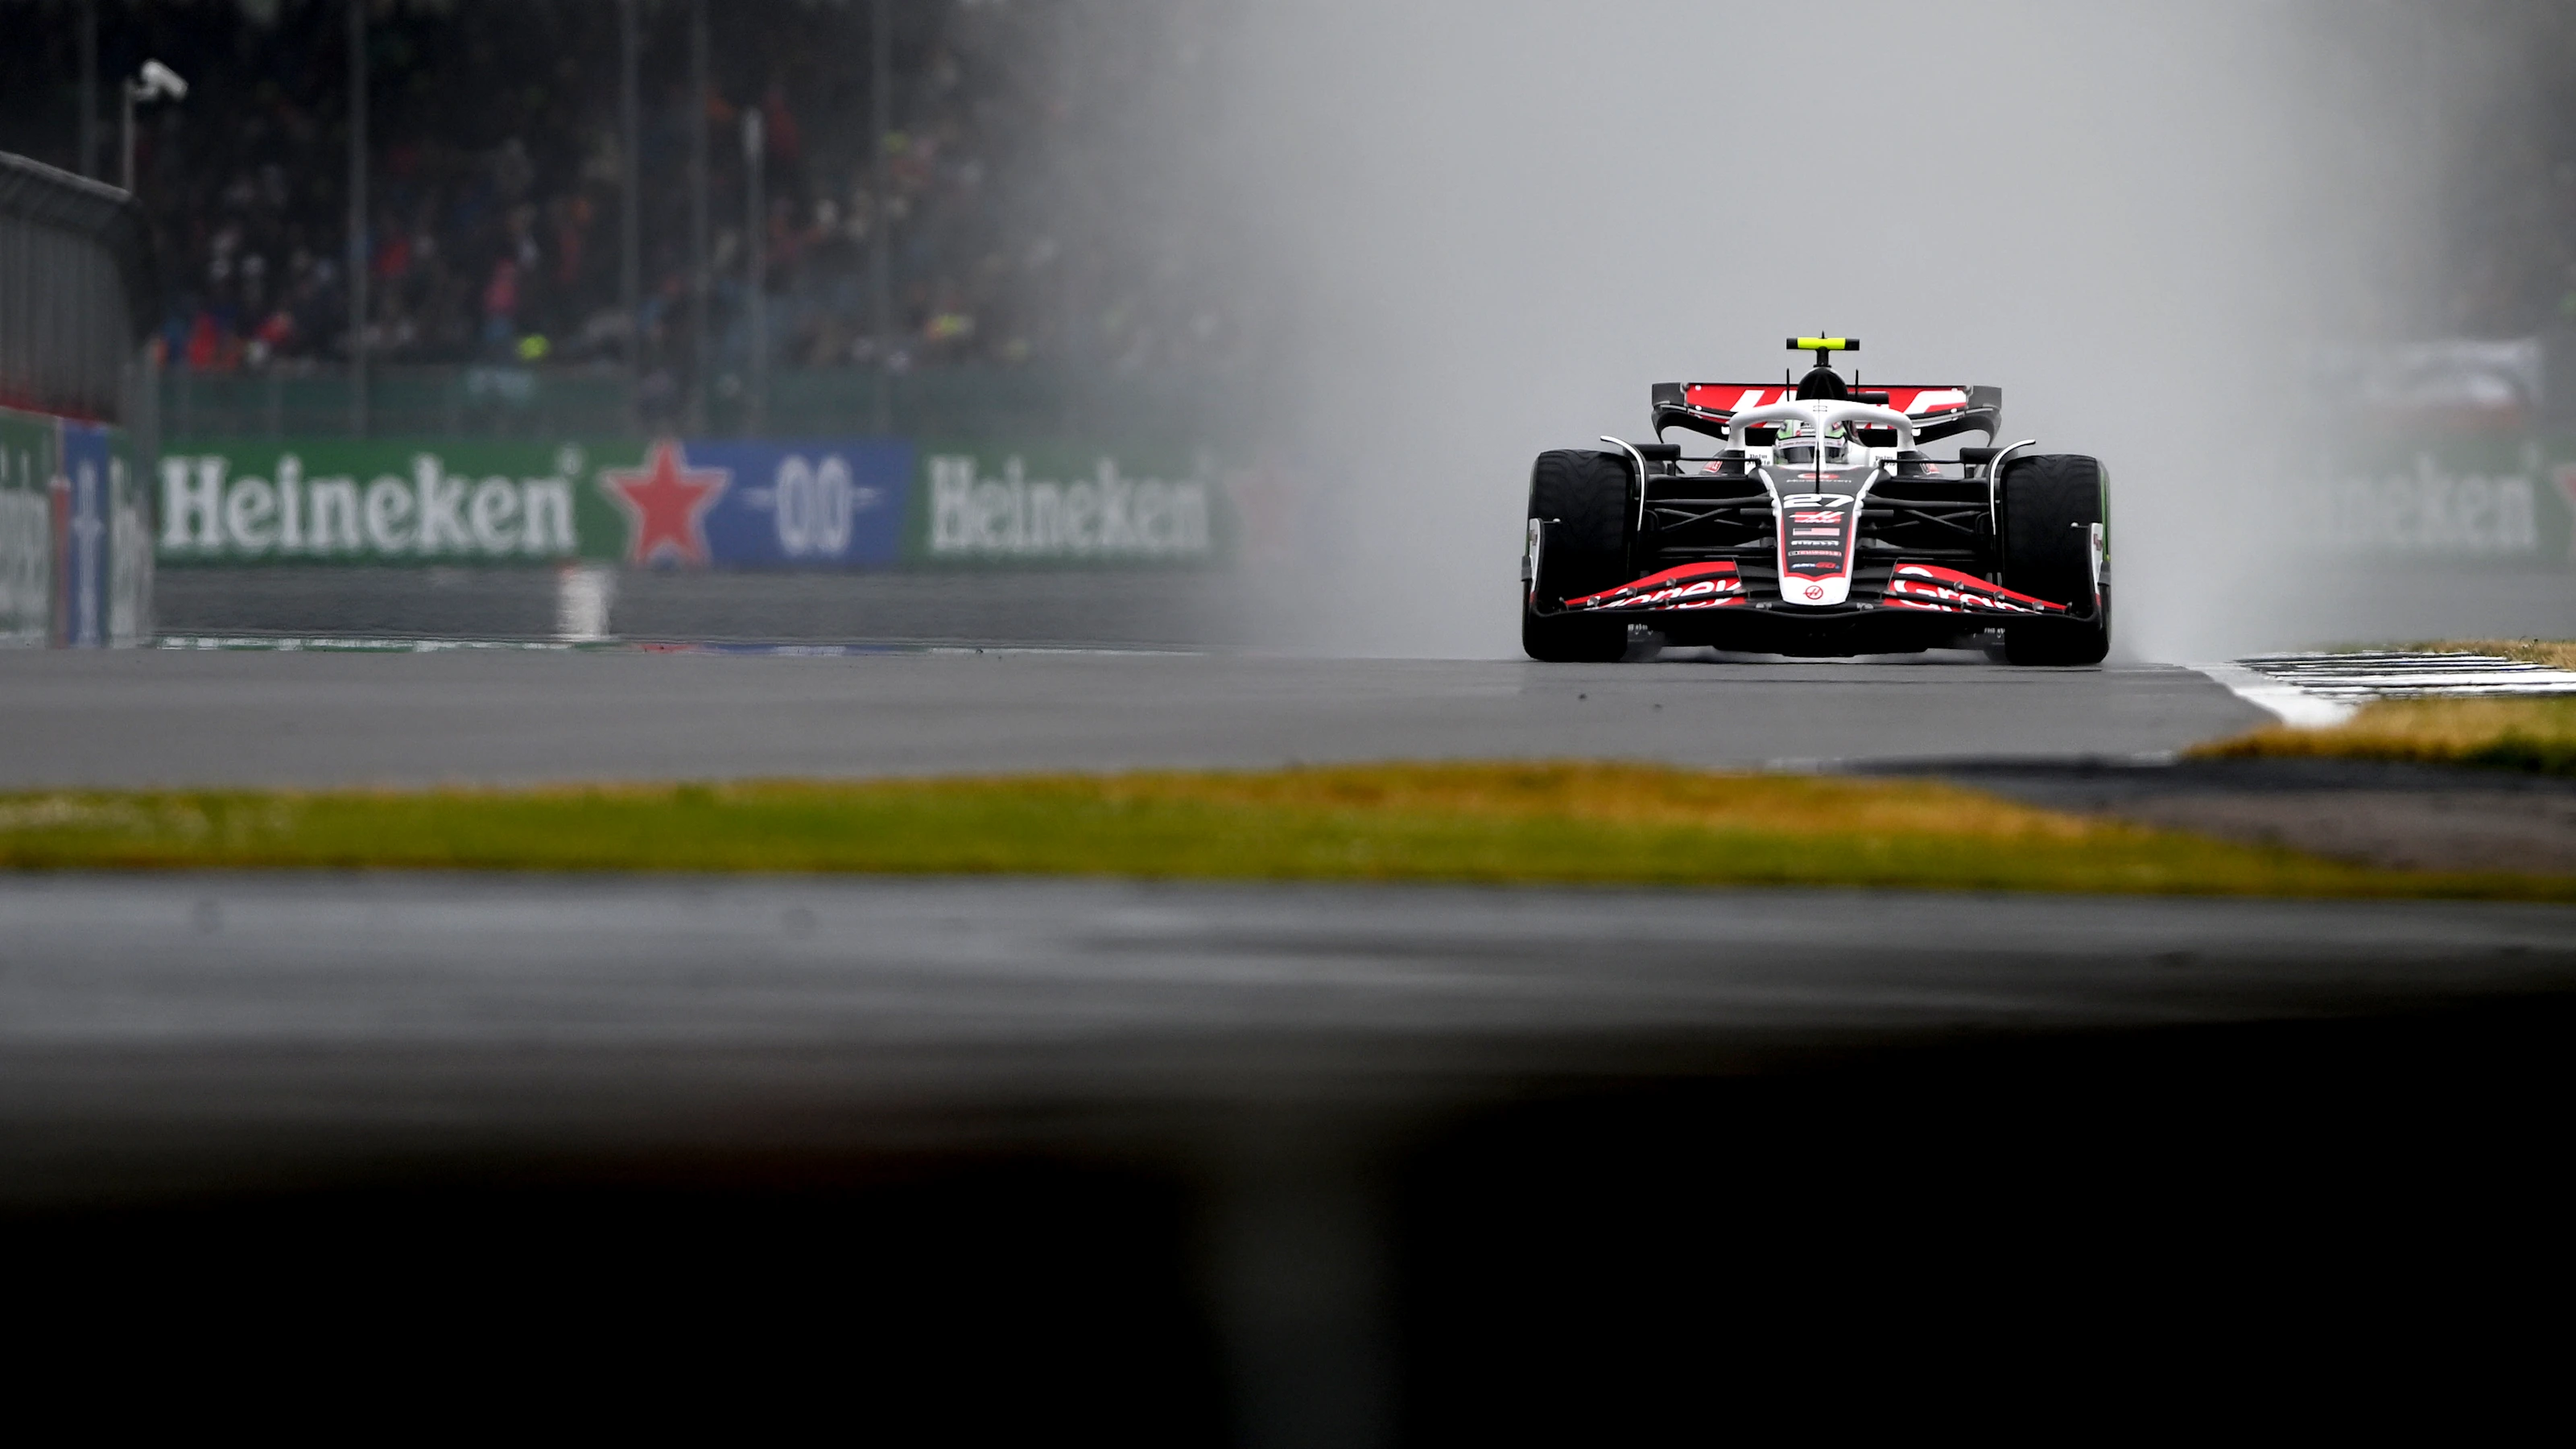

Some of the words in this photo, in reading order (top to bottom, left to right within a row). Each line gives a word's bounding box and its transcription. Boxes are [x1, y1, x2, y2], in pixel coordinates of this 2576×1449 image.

[160, 452, 576, 554] Heineken
[928, 455, 1209, 555] Heineken
[1783, 493, 1855, 509] 27
[2322, 452, 2537, 549] neken
